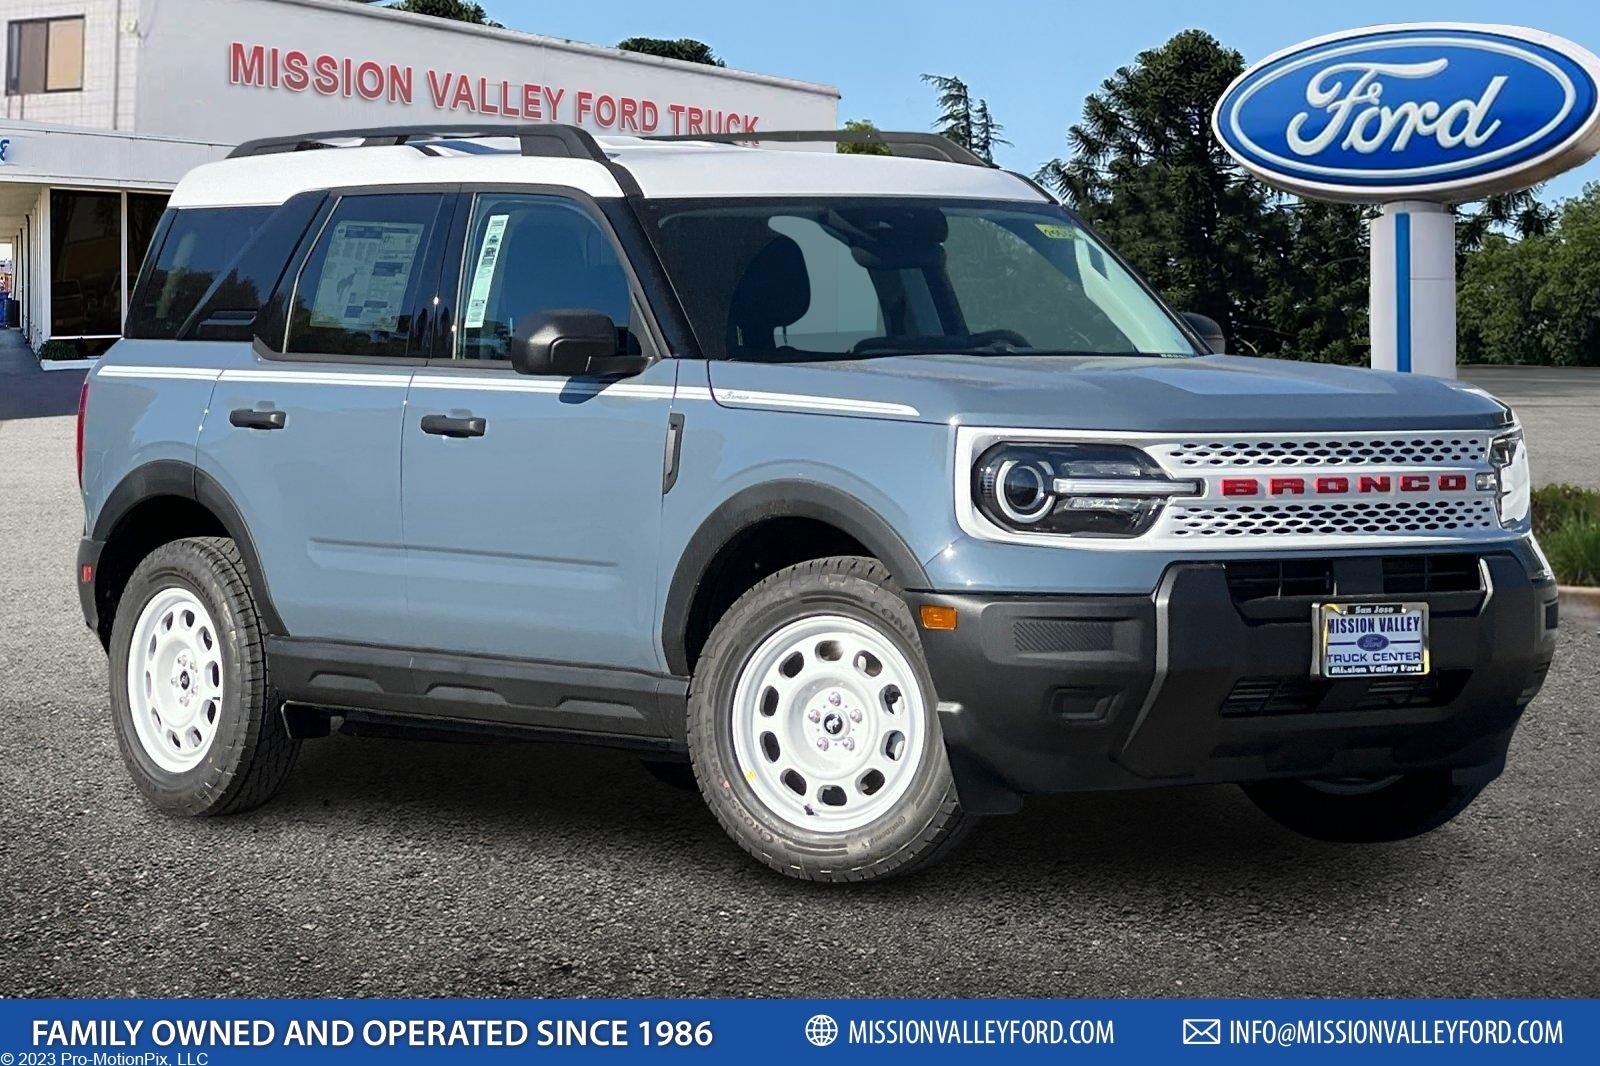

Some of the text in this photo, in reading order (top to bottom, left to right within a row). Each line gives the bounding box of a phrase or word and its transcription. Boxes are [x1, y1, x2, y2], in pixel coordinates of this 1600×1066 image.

[230, 42, 759, 145] MISSION VALLEY FORD TRUCK
[1286, 58, 1508, 156] Ford
[1221, 474, 1467, 496] BRONCO
[1355, 605, 1394, 614] San Jose
[1328, 616, 1420, 634] MISSION VALLEY
[1327, 651, 1421, 663] TRUCK CENTER
[1331, 664, 1422, 674] Mission Valley Ford
